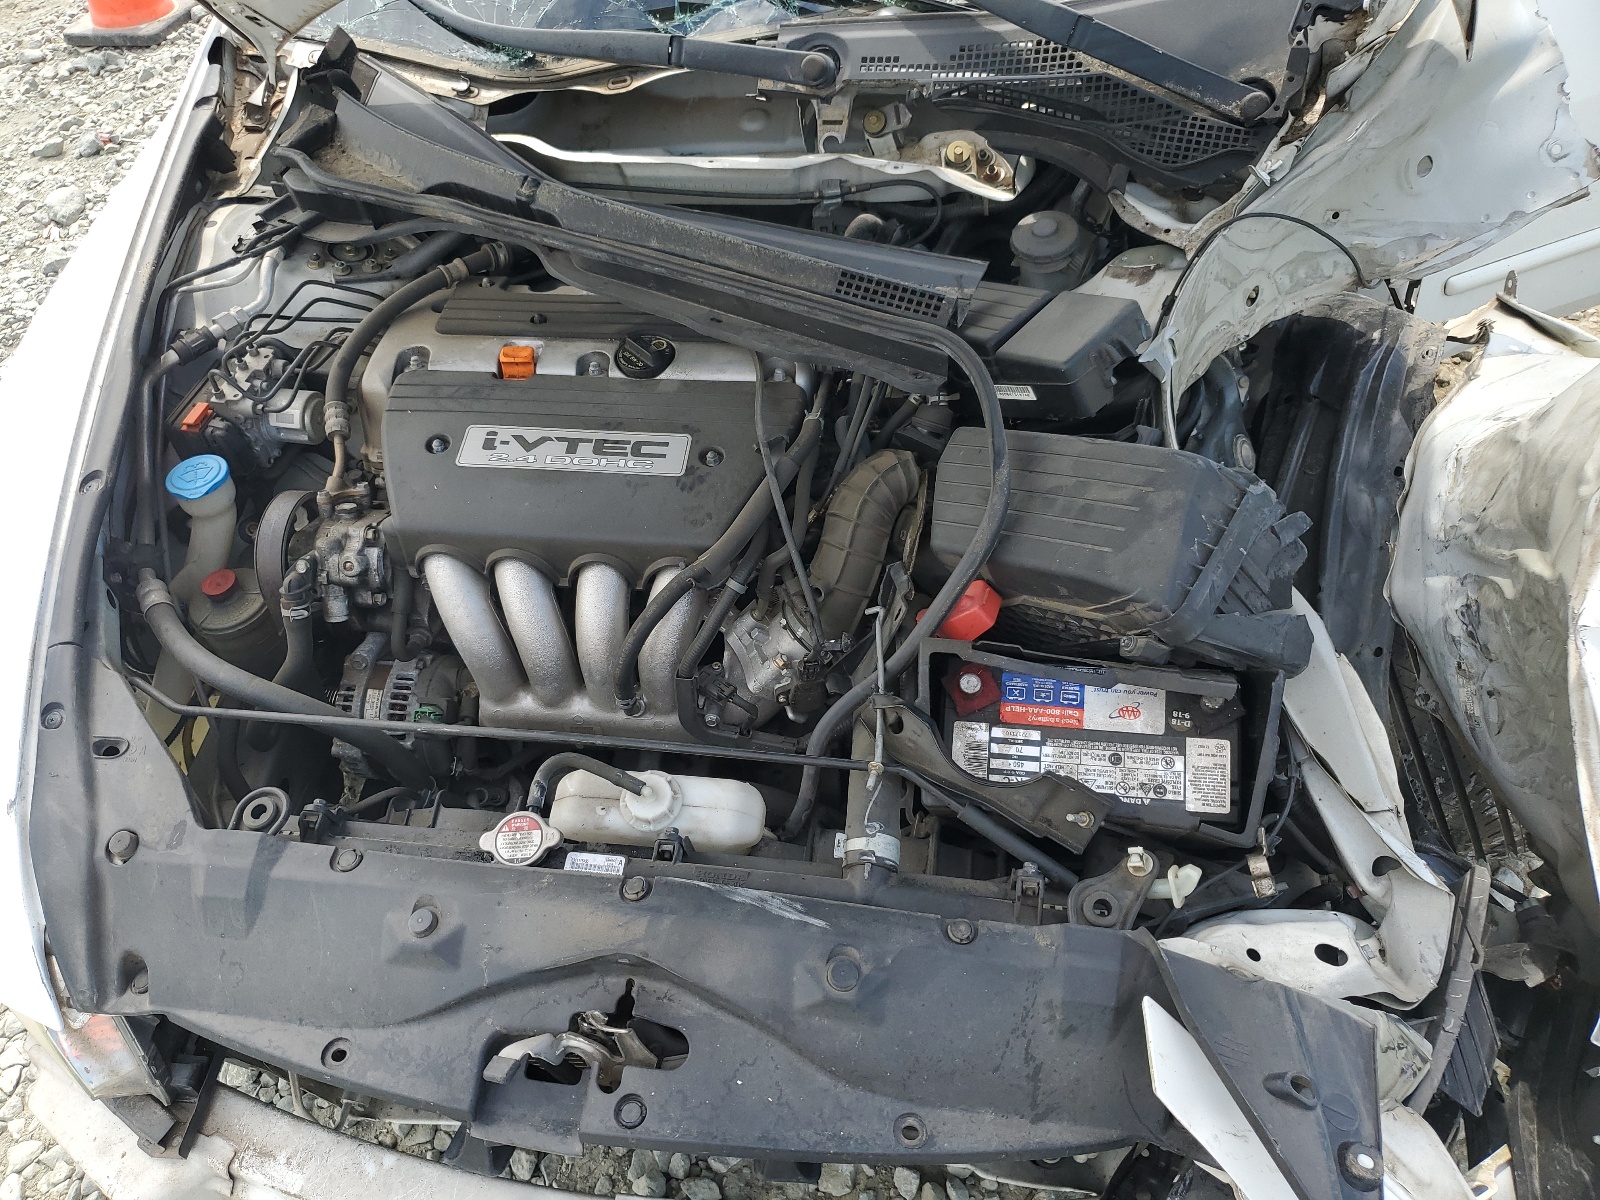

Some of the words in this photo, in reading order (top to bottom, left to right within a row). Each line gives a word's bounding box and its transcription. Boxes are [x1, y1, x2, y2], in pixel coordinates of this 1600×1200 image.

[482, 430, 670, 459] i-VTEC
[488, 453, 537, 464] 2.4
[544, 455, 654, 470] DOHC
[1005, 705, 1060, 715] 800-AAA-HELP
[1062, 709, 1079, 717] Call:
[1118, 706, 1140, 718] AAA
[1172, 710, 1190, 718] 9-18
[1027, 714, 1054, 723] battery?
[1171, 718, 1191, 726] D-18
